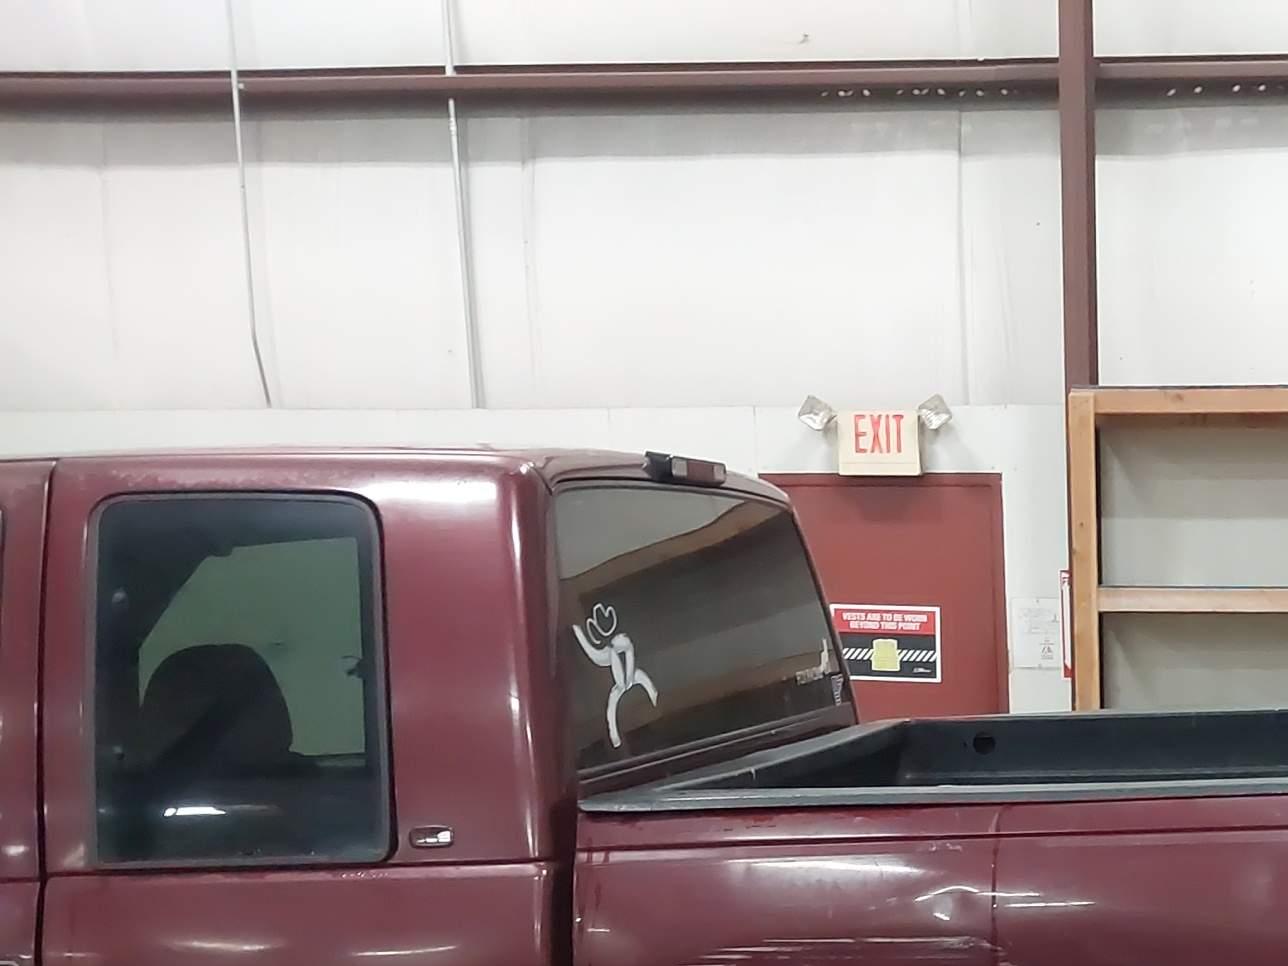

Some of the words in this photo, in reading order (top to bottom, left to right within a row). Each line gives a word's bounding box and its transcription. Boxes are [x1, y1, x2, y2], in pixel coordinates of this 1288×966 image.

[854, 414, 905, 454] EXIT
[842, 612, 866, 621] VESTS
[866, 613, 881, 621] ARE
[882, 613, 893, 622] TO
[893, 614, 904, 622] BE
[849, 621, 880, 630] BEYOND
[880, 622, 897, 630] THIS
[898, 622, 921, 631] POINT
